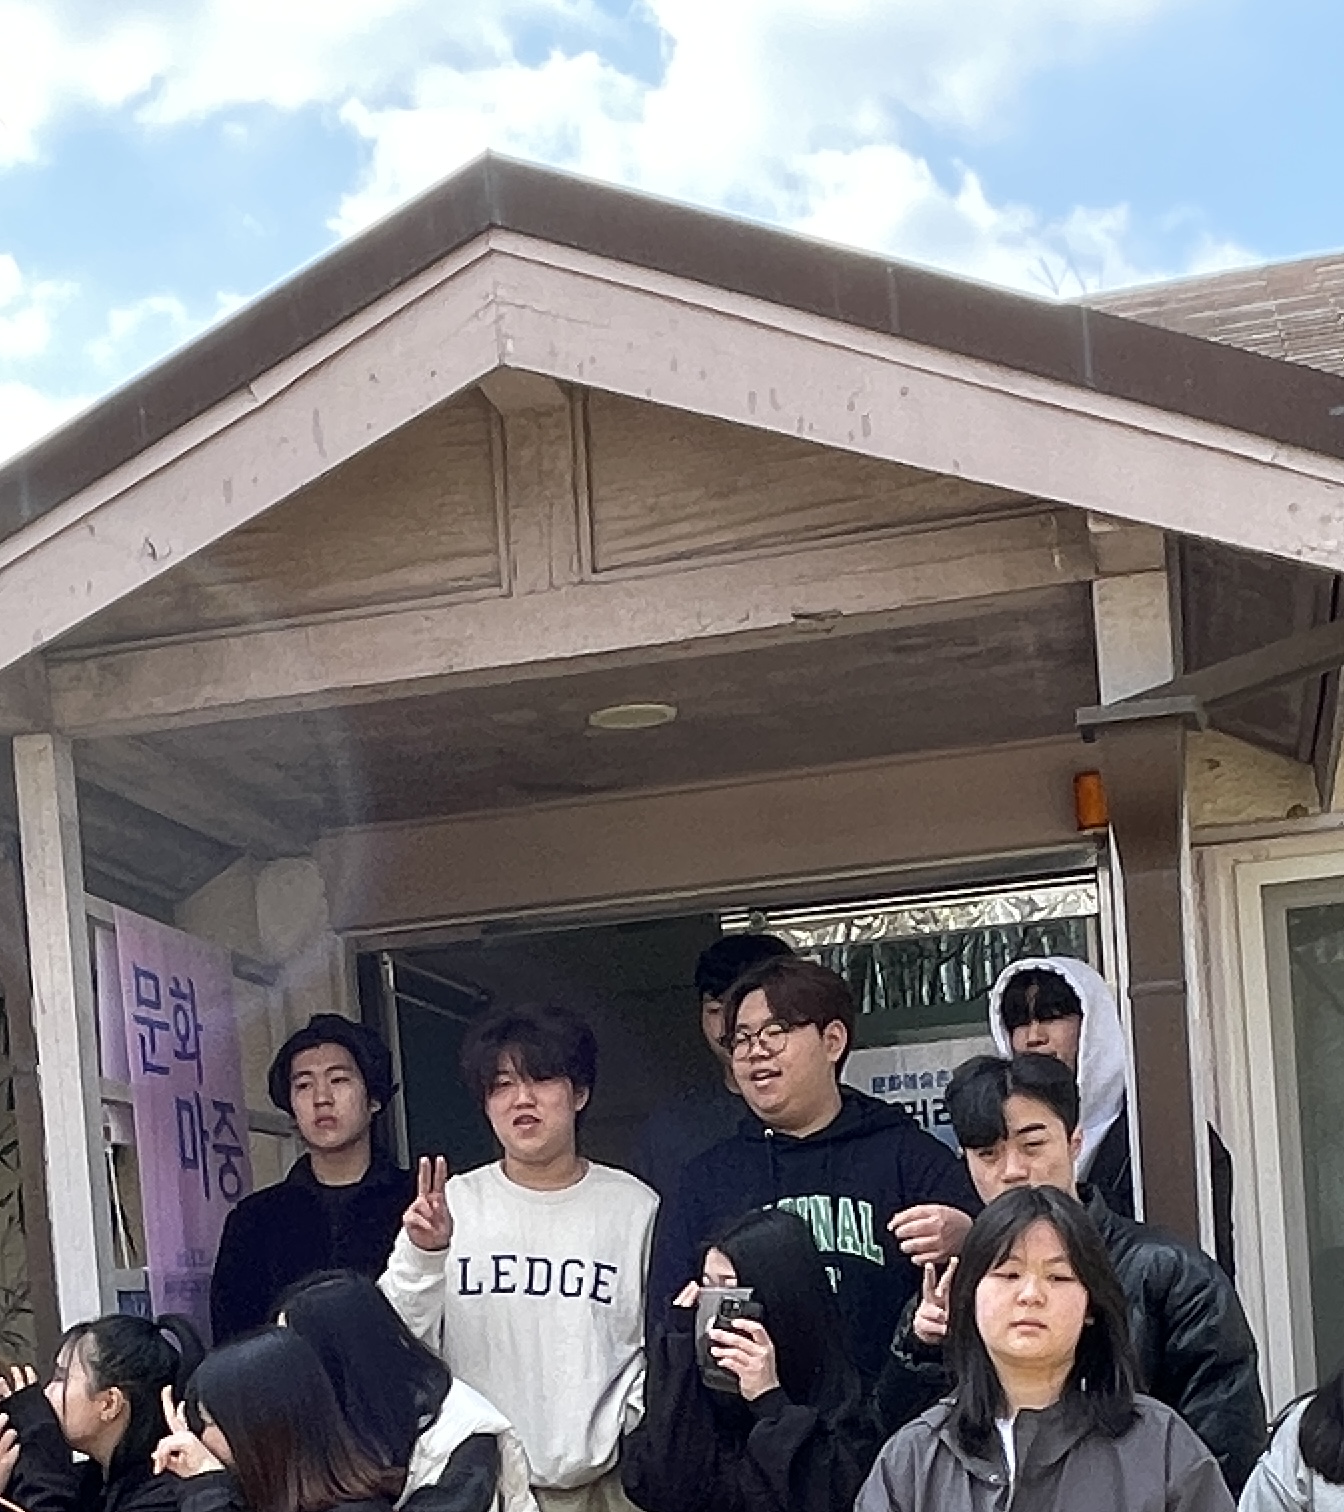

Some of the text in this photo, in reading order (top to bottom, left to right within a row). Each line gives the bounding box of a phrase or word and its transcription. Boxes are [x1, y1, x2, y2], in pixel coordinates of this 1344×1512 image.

[133, 962, 204, 1085] 문화
[176, 1090, 244, 1201] 마중
[457, 1254, 618, 1304] LEDGE
